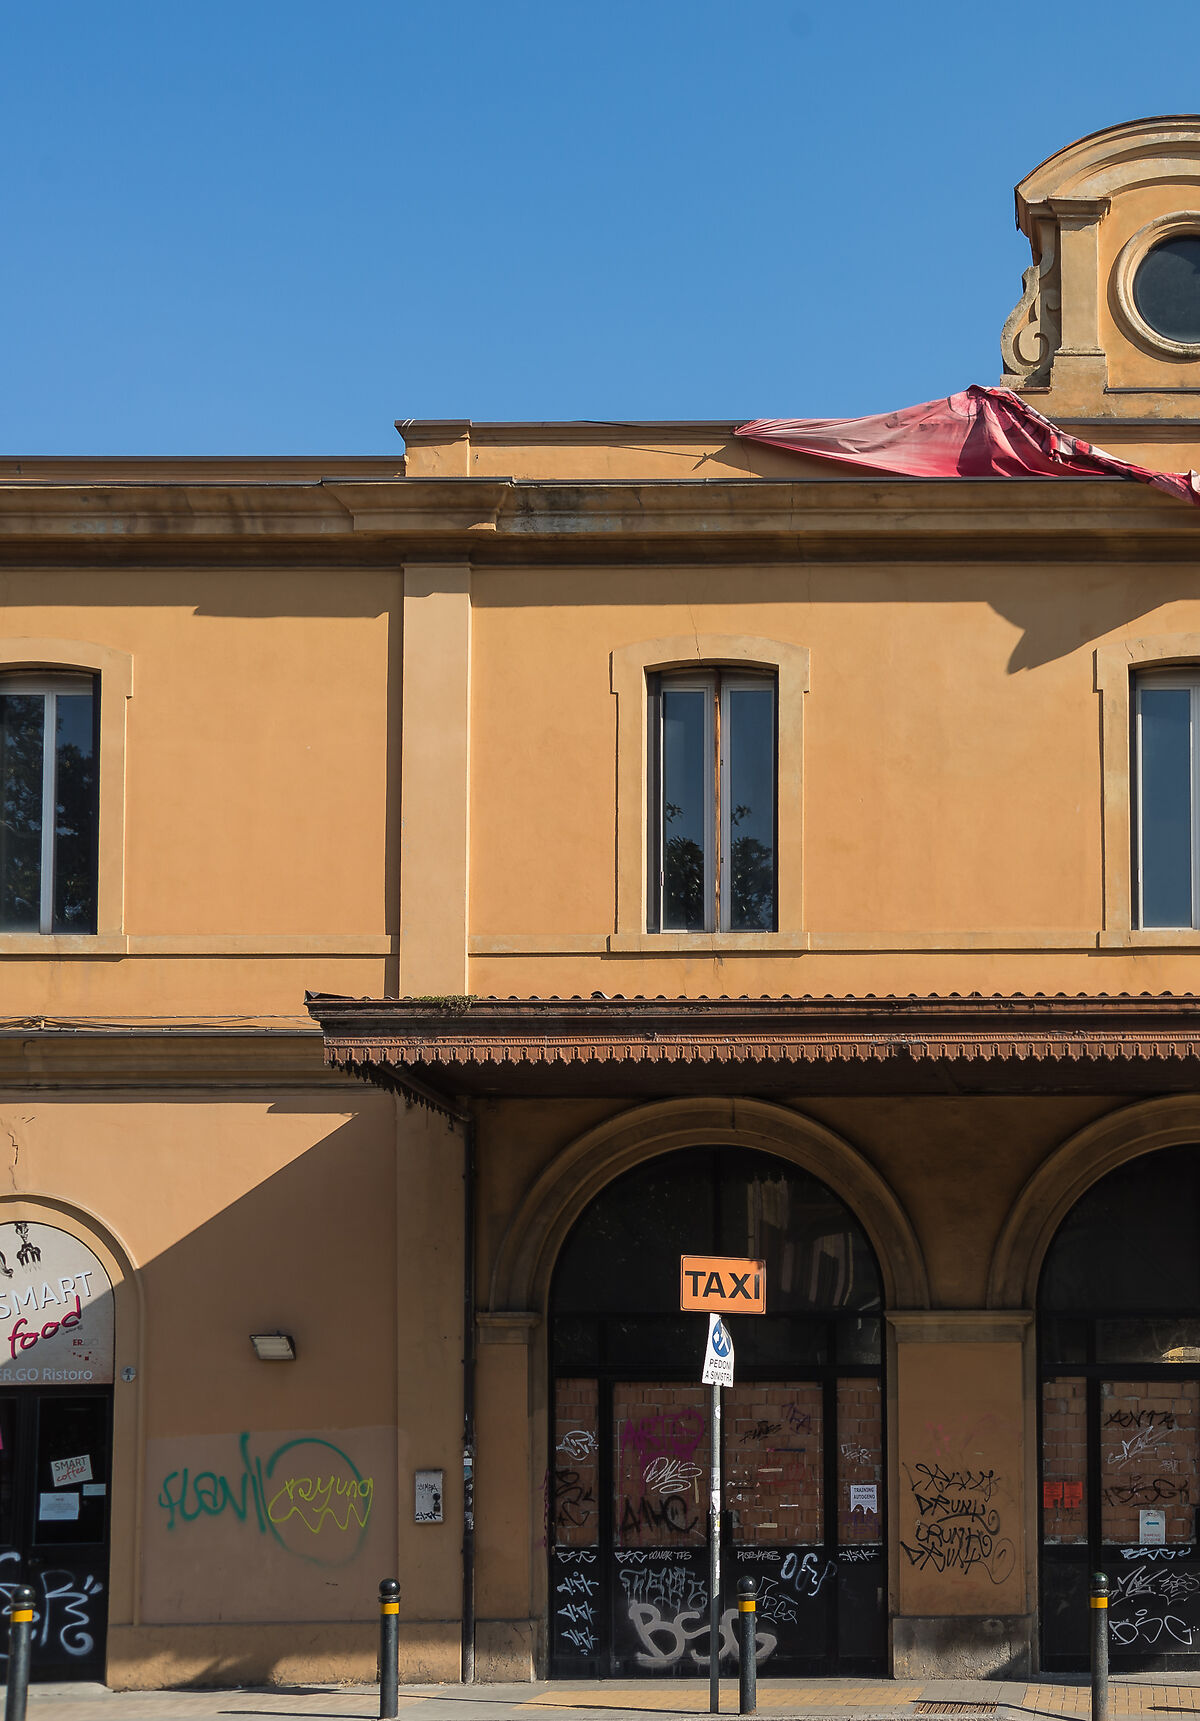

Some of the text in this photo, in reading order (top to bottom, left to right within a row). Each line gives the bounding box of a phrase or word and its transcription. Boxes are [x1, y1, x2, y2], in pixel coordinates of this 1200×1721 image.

[0, 1271, 93, 1319] SMART
[684, 1270, 760, 1300] TAXI
[8, 1294, 82, 1360] food
[43, 1367, 93, 1381] Ristoro
[54, 1457, 87, 1471] SMART
[56, 1465, 87, 1482] coffee
